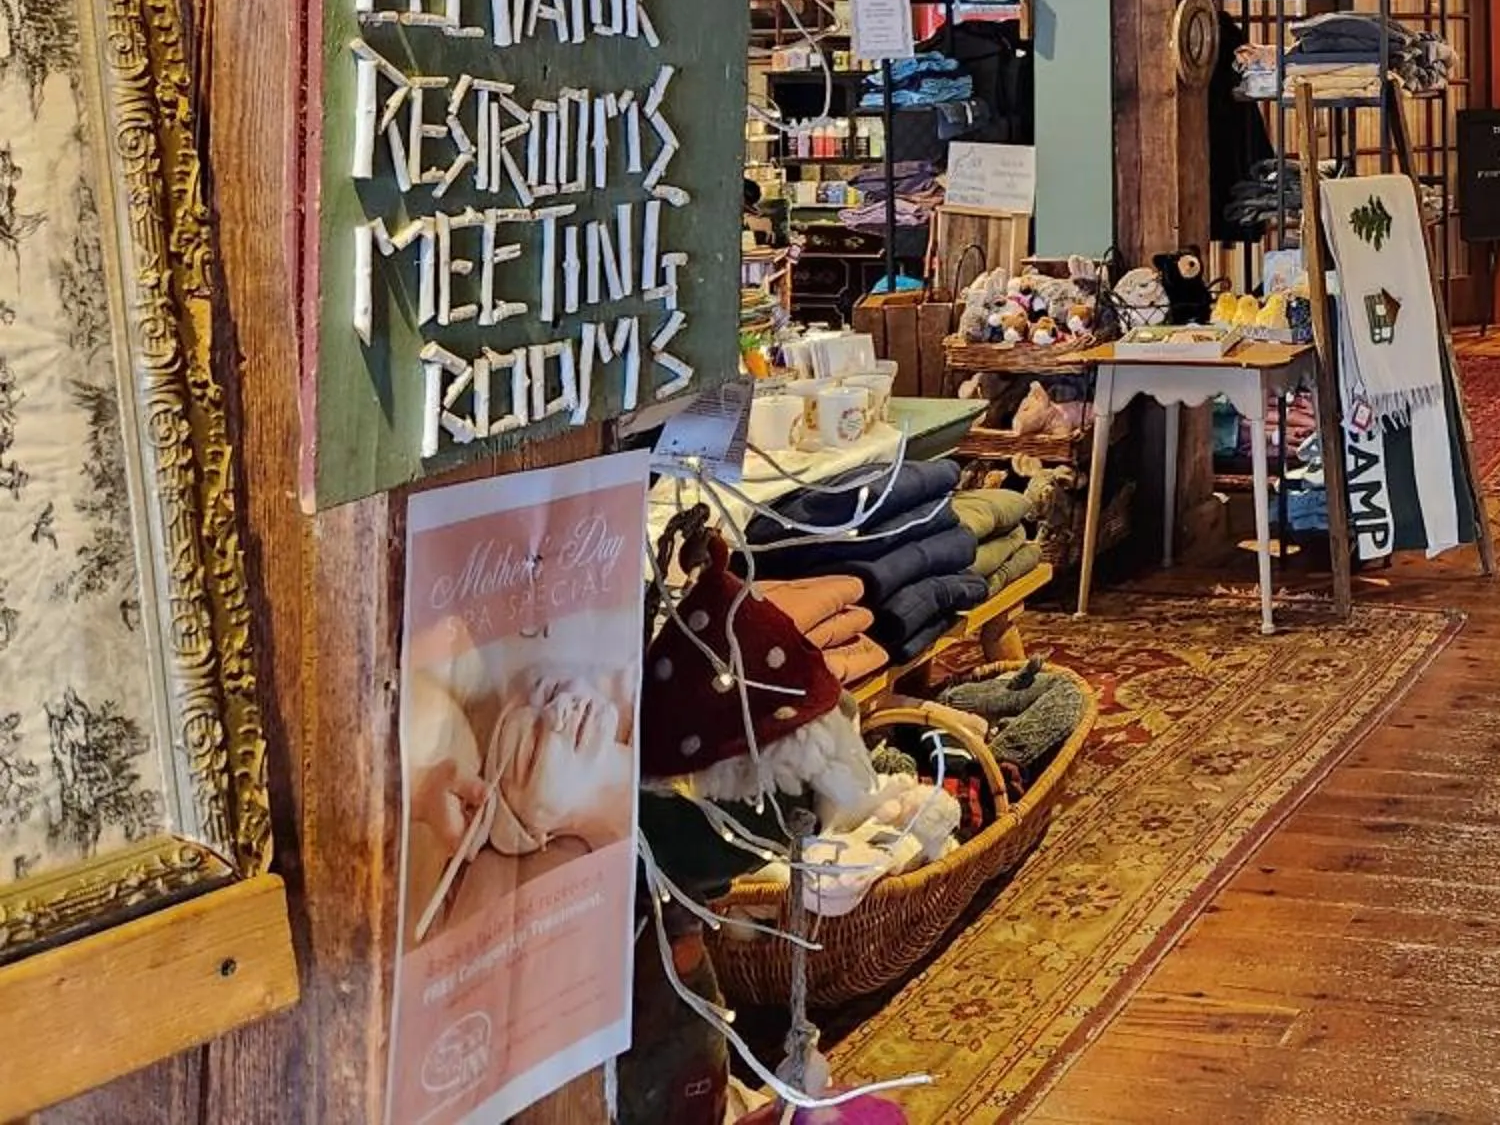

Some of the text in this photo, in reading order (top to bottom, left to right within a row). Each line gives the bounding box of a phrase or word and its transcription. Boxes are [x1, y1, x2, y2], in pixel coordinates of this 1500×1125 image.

[349, 38, 681, 206] RESTROOMS
[352, 183, 691, 346] MEETING
[420, 309, 695, 458] ROOMS
[1346, 428, 1391, 551] AMP
